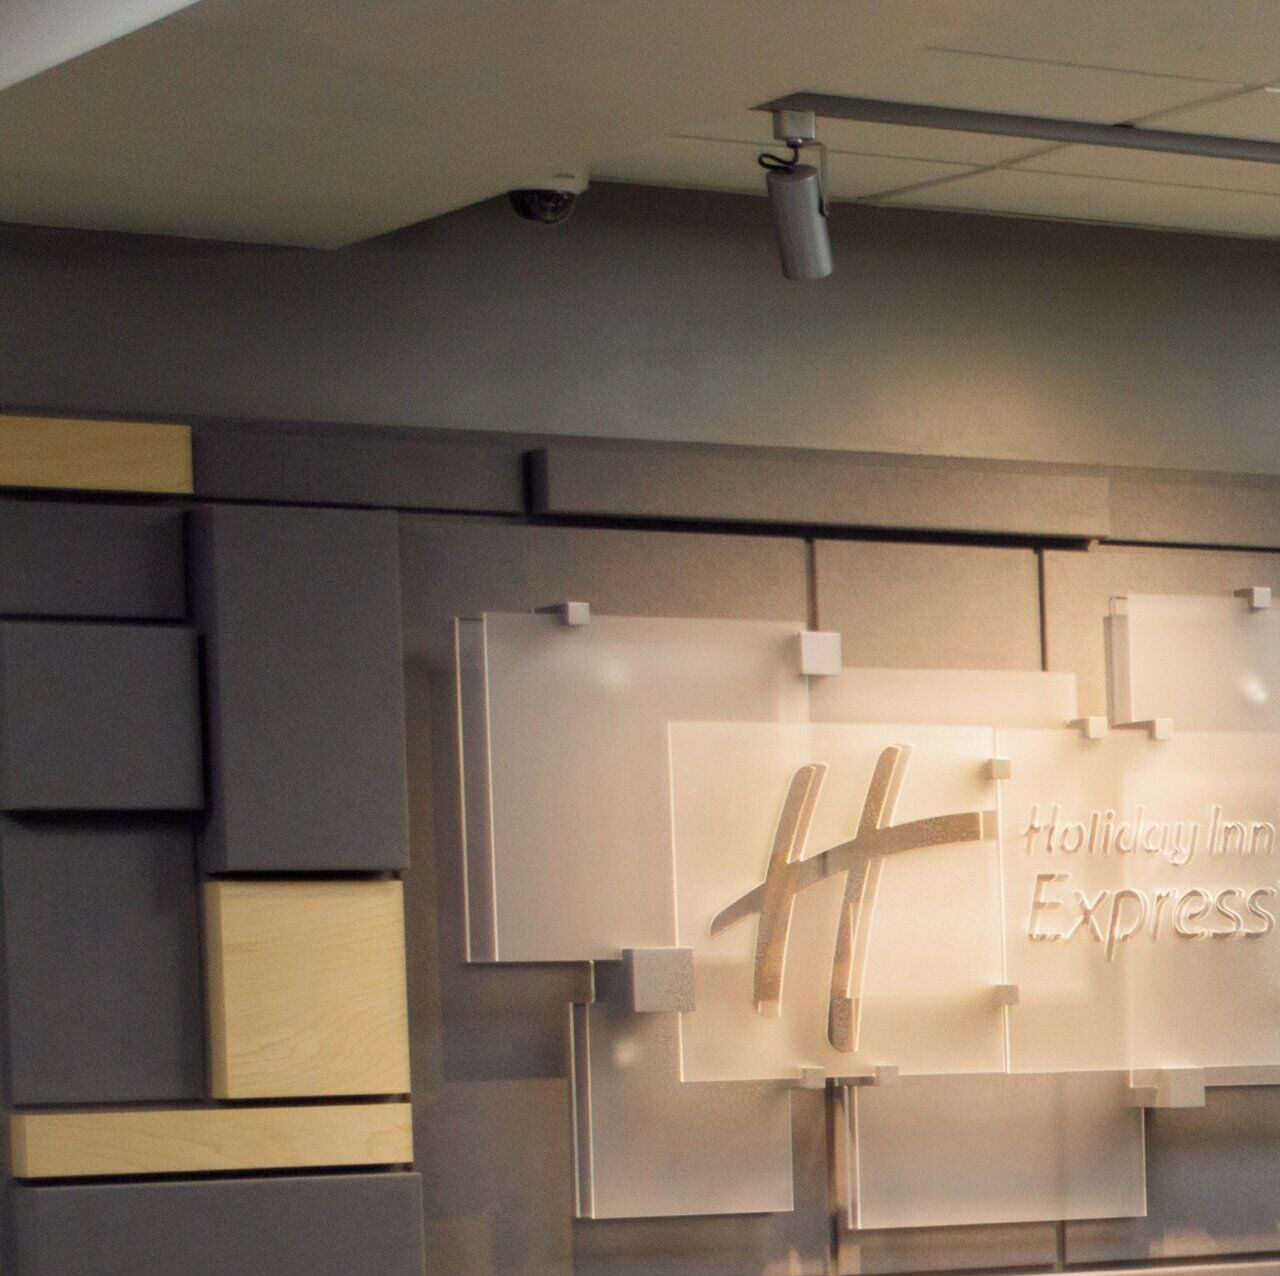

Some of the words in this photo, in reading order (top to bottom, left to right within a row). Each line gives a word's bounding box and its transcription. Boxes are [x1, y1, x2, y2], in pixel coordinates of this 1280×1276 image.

[1024, 803, 1199, 866] Holiday
[1207, 804, 1276, 855] Inn
[1028, 873, 1278, 962] Express
